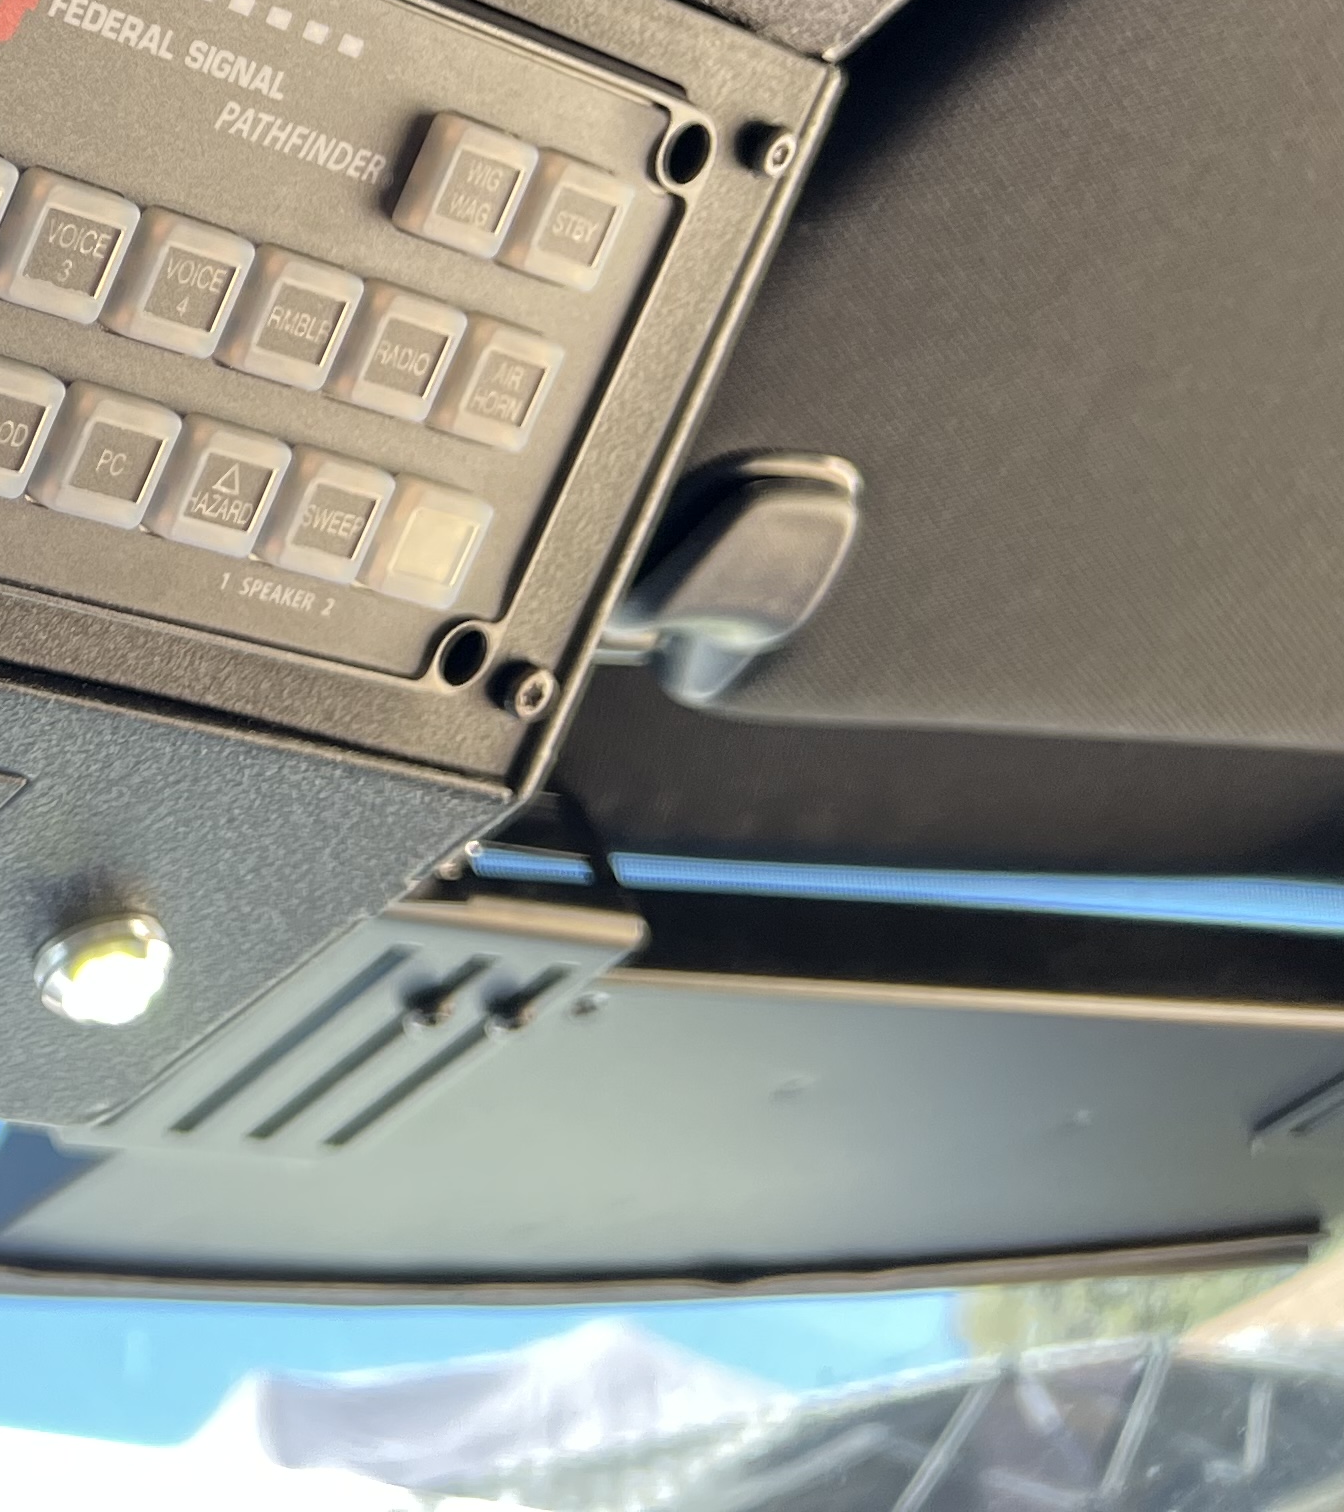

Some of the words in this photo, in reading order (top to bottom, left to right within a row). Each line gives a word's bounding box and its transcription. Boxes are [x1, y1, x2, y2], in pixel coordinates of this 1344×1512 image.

[183, 40, 285, 100] SIGNAL
[466, 161, 505, 190] WIG
[451, 194, 492, 226] WAG
[45, 218, 111, 258] VOICE
[552, 211, 598, 243] STBY
[57, 258, 73, 281] 3
[164, 255, 226, 292] VOICE
[175, 297, 189, 317] 4
[377, 343, 431, 377] RADIO
[495, 361, 522, 390] AIR
[473, 391, 522, 420] HORN
[96, 449, 129, 477] PC
[185, 491, 255, 526] HAZARD
[302, 505, 363, 541] SWEEP
[219, 573, 232, 590] 1
[239, 575, 317, 613] SPEAKER
[320, 597, 335, 617] 2
